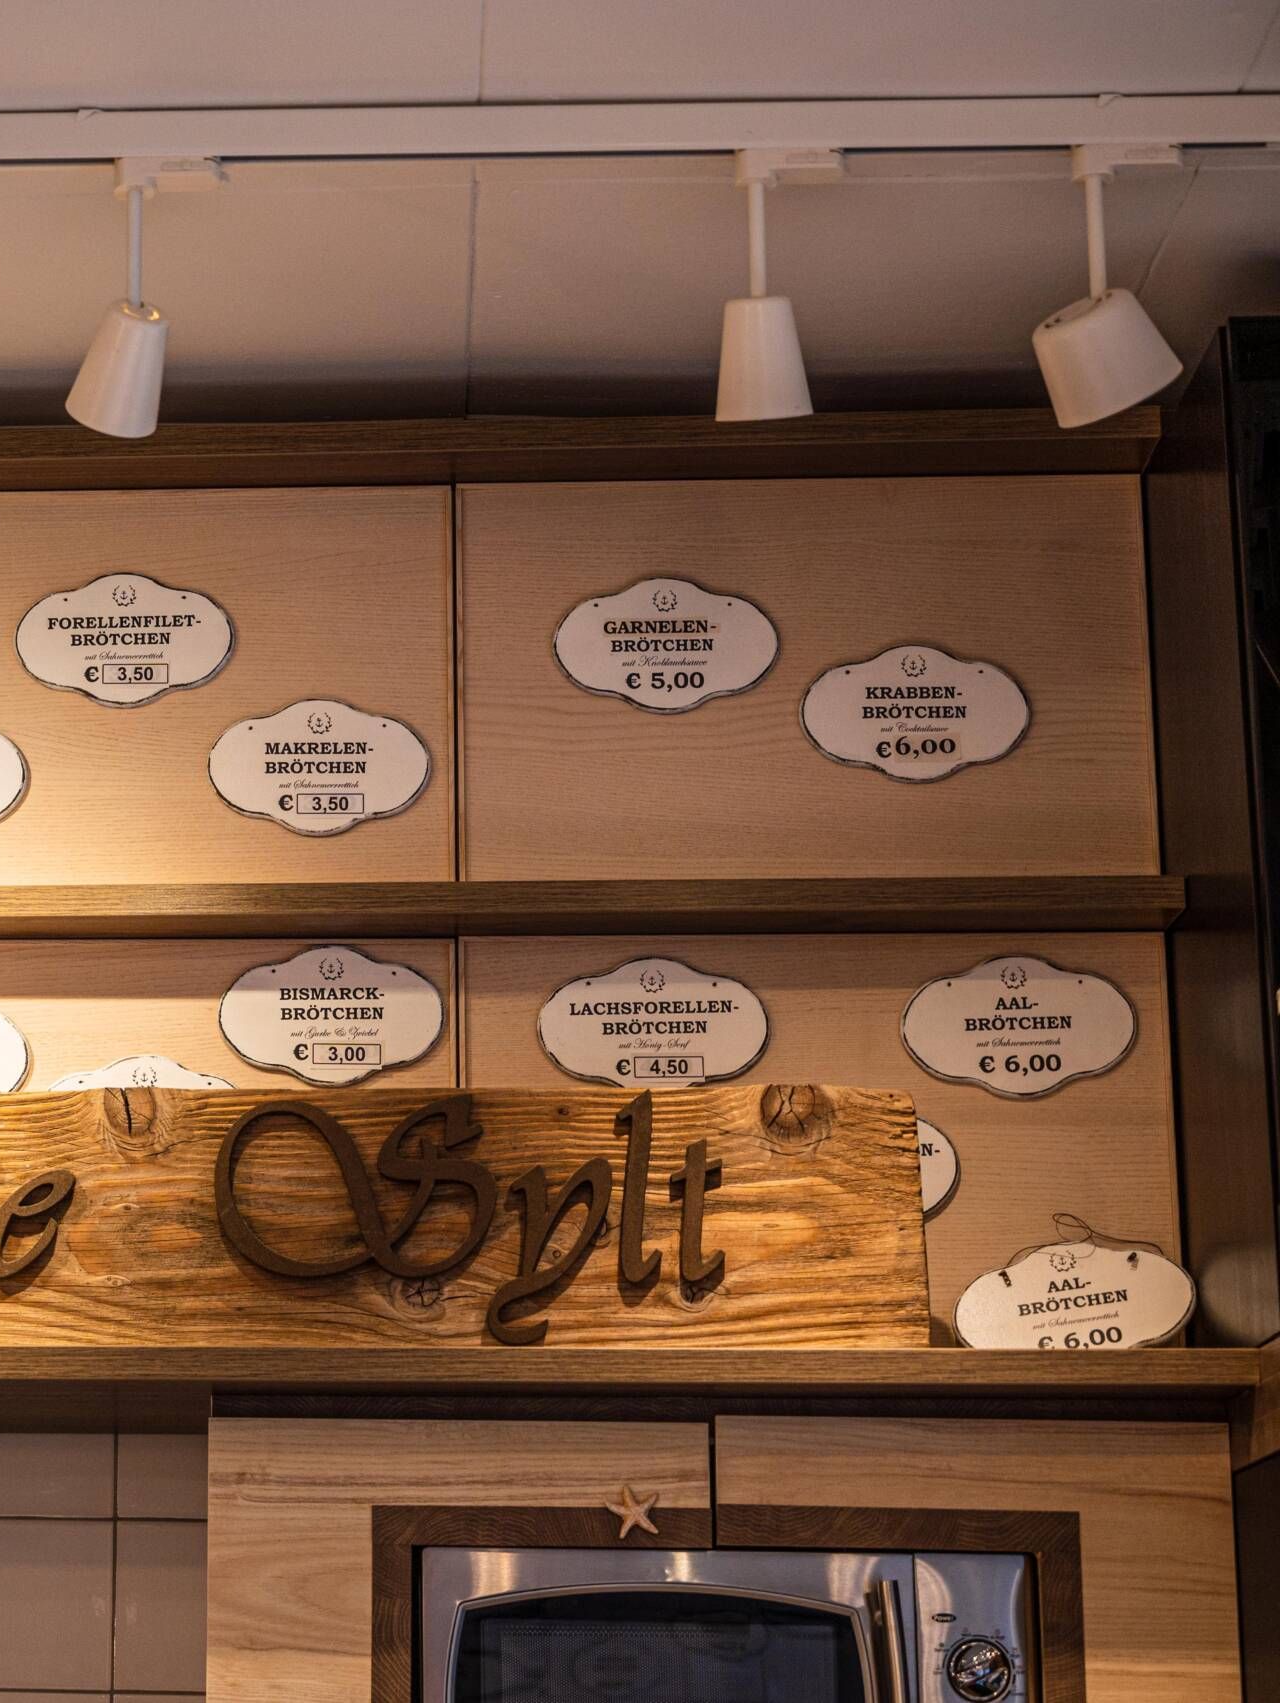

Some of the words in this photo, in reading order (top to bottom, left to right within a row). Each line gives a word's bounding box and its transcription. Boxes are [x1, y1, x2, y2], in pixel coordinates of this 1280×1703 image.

[47, 614, 202, 630] FORELLENFILET-
[603, 619, 718, 634] GARNELEN-
[70, 631, 171, 647] BRÖTCHEN
[610, 637, 714, 653] BRÖTCHEN
[84, 652, 97, 661] mit
[99, 650, 164, 661] Sahnemeerrettich
[621, 658, 636, 667] mit
[83, 666, 99, 683] €
[117, 667, 154, 683] 3,50
[625, 672, 641, 689] €
[651, 671, 705, 692] 5,00
[865, 686, 963, 699] KRABBEN-
[862, 703, 968, 719] BRÖTCHEN
[880, 725, 894, 733] mit
[264, 742, 374, 755] MAKRELEN-
[264, 759, 366, 774] BRÖTCHEN
[278, 780, 292, 789] mit
[293, 778, 360, 789] Sahnemeerrettich
[278, 795, 294, 811] €
[311, 796, 349, 814] 3,50
[279, 987, 385, 1000] BISMARCK-
[569, 1000, 740, 1016] LACHSFORELLEN-
[995, 997, 1039, 1010] AAL-
[280, 1004, 385, 1020] BRÖTCHEN
[602, 1019, 707, 1035] BRÖTCHEN
[964, 1014, 1072, 1031] BRÖTCHEN
[290, 1029, 303, 1037] mit
[347, 1026, 379, 1040] Zwiebel
[618, 1041, 631, 1049] mit
[976, 1038, 989, 1048] mit
[991, 1036, 1061, 1048] Sahnemeerrettich
[293, 1044, 309, 1060] €
[328, 1046, 366, 1064] 3,00
[615, 1059, 631, 1075] €
[649, 1059, 689, 1077] 4,50
[978, 1056, 995, 1073] €
[1004, 1054, 1062, 1076] 6,00
[214, 1089, 726, 1346] Sylt
[1047, 1277, 1092, 1293] AAL-
[1017, 1289, 1128, 1317] BRÖTCHEN
[1032, 1323, 1046, 1331] mit
[1064, 1326, 1123, 1350] 6,00
